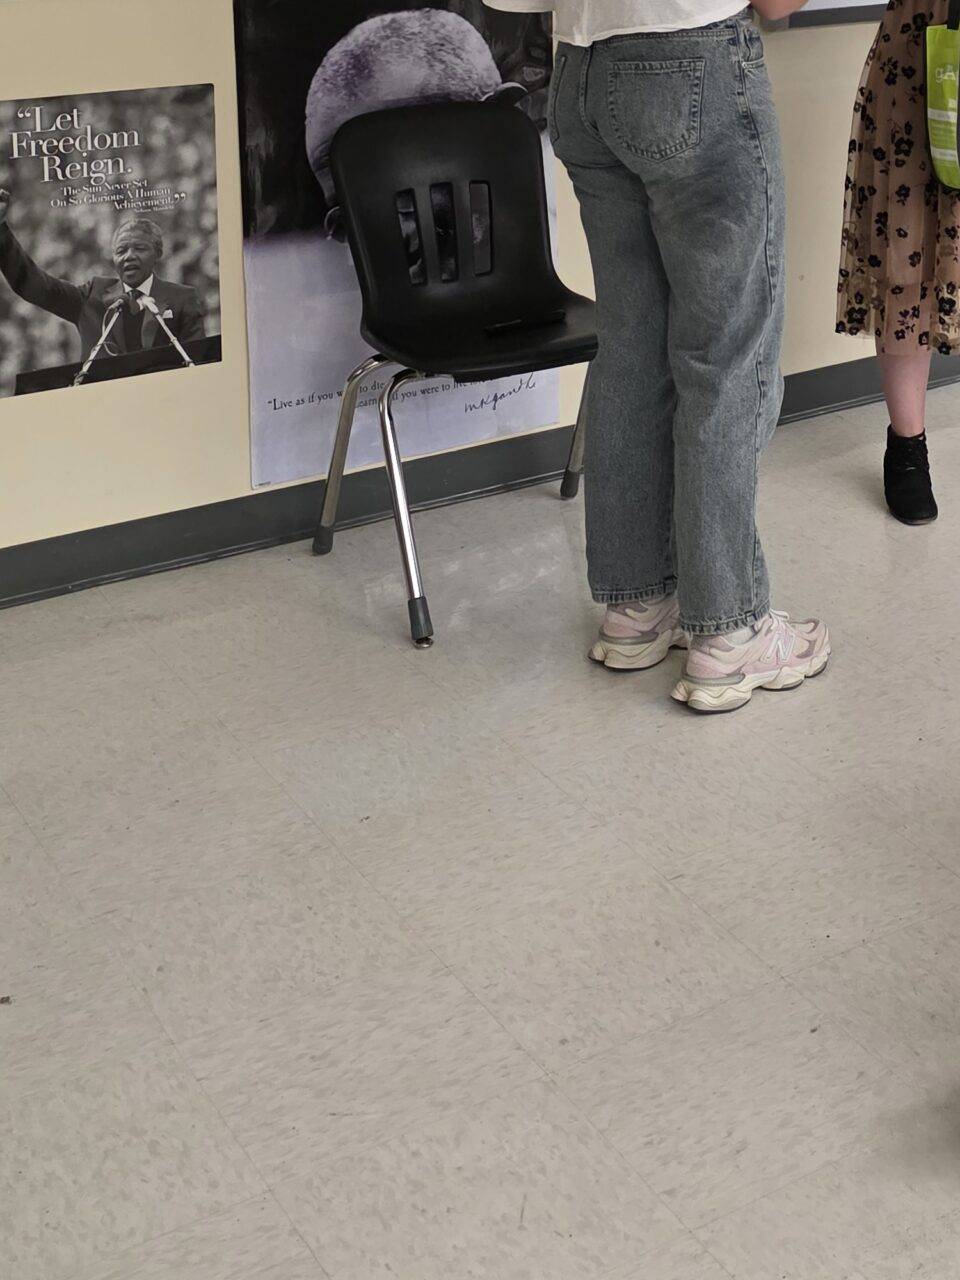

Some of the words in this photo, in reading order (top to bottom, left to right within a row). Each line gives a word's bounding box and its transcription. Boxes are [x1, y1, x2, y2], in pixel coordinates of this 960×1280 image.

[9, 125, 141, 159] Freedom
[40, 154, 133, 185] Reign.
[104, 181, 130, 191] Never
[132, 179, 148, 187] Set
[50, 199, 67, 208] On
[68, 197, 82, 206] So
[84, 193, 124, 203] Glorious
[135, 188, 171, 198] Human
[296, 398, 305, 406] as
[308, 392, 316, 403] if
[317, 393, 333, 403] you
[400, 390, 417, 402] you
[420, 386, 439, 394] were
[442, 383, 450, 391] to
